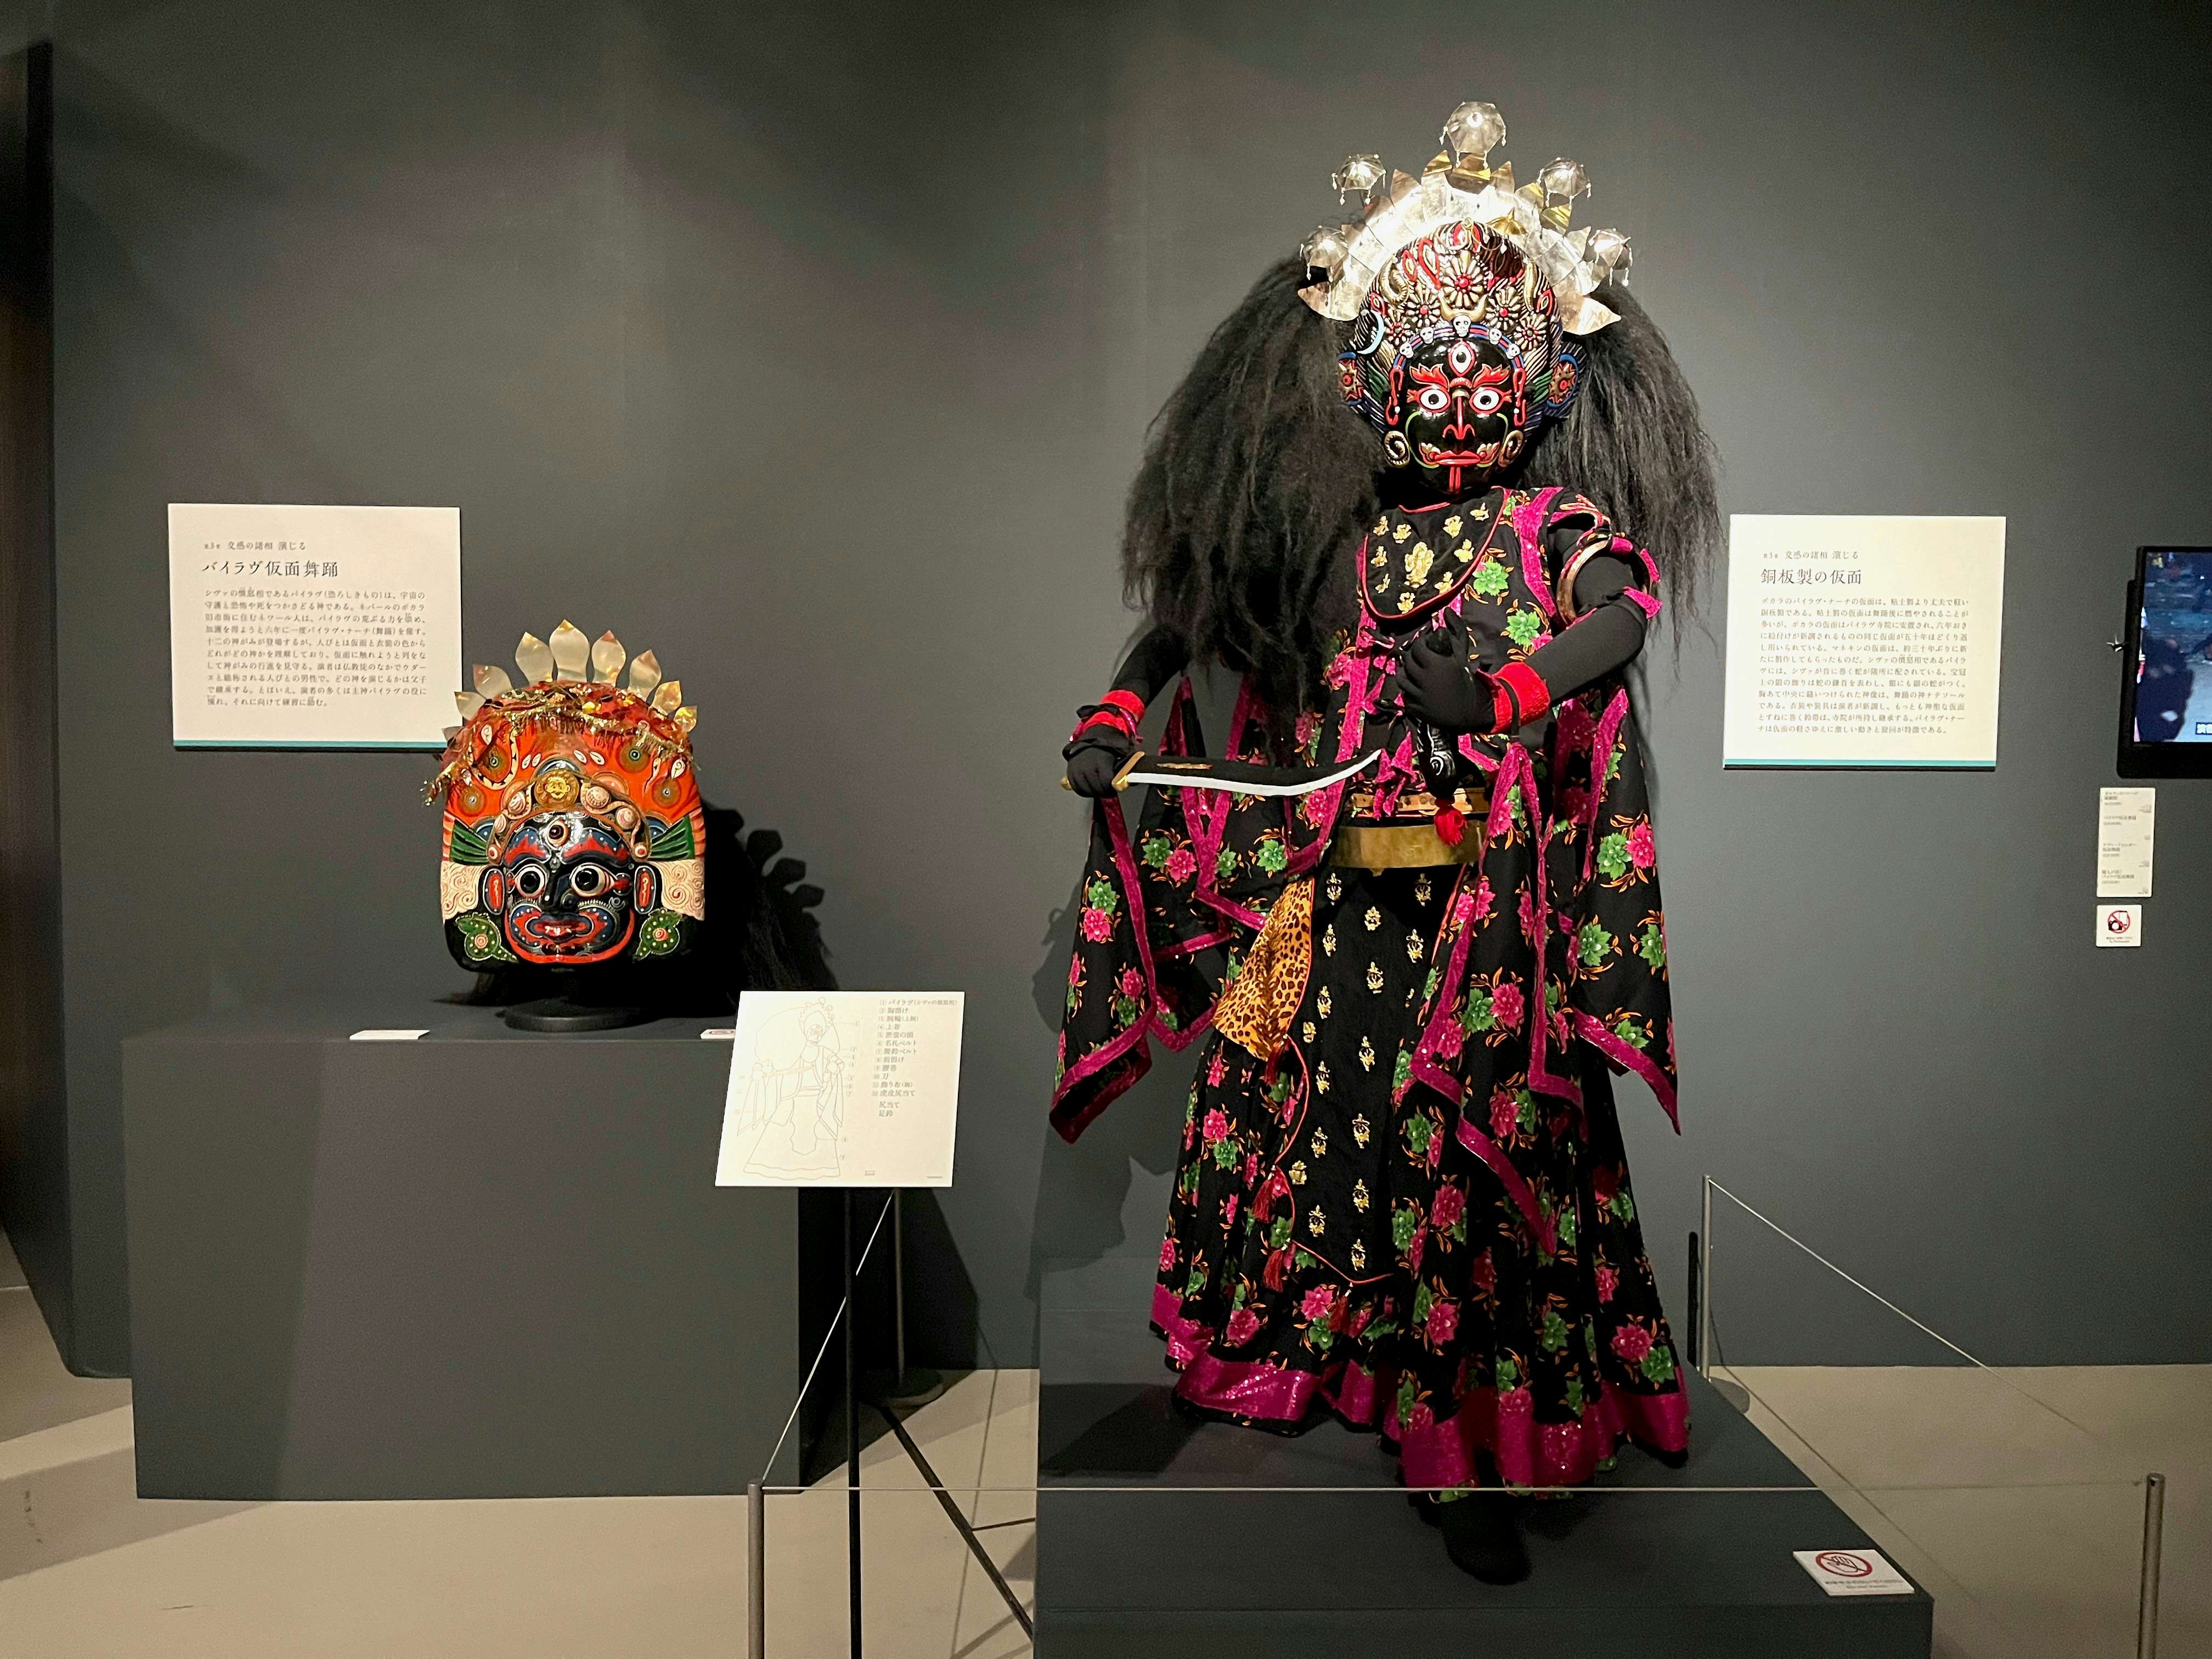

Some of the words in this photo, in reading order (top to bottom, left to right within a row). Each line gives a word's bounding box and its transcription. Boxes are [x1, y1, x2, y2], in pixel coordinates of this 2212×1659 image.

[278, 541, 306, 550] 演じる
[1832, 551, 1858, 559] 演じる
[202, 561, 337, 577] バイラヴ仮面舞踊
[1761, 569, 1861, 584] 銅板製の仮面
